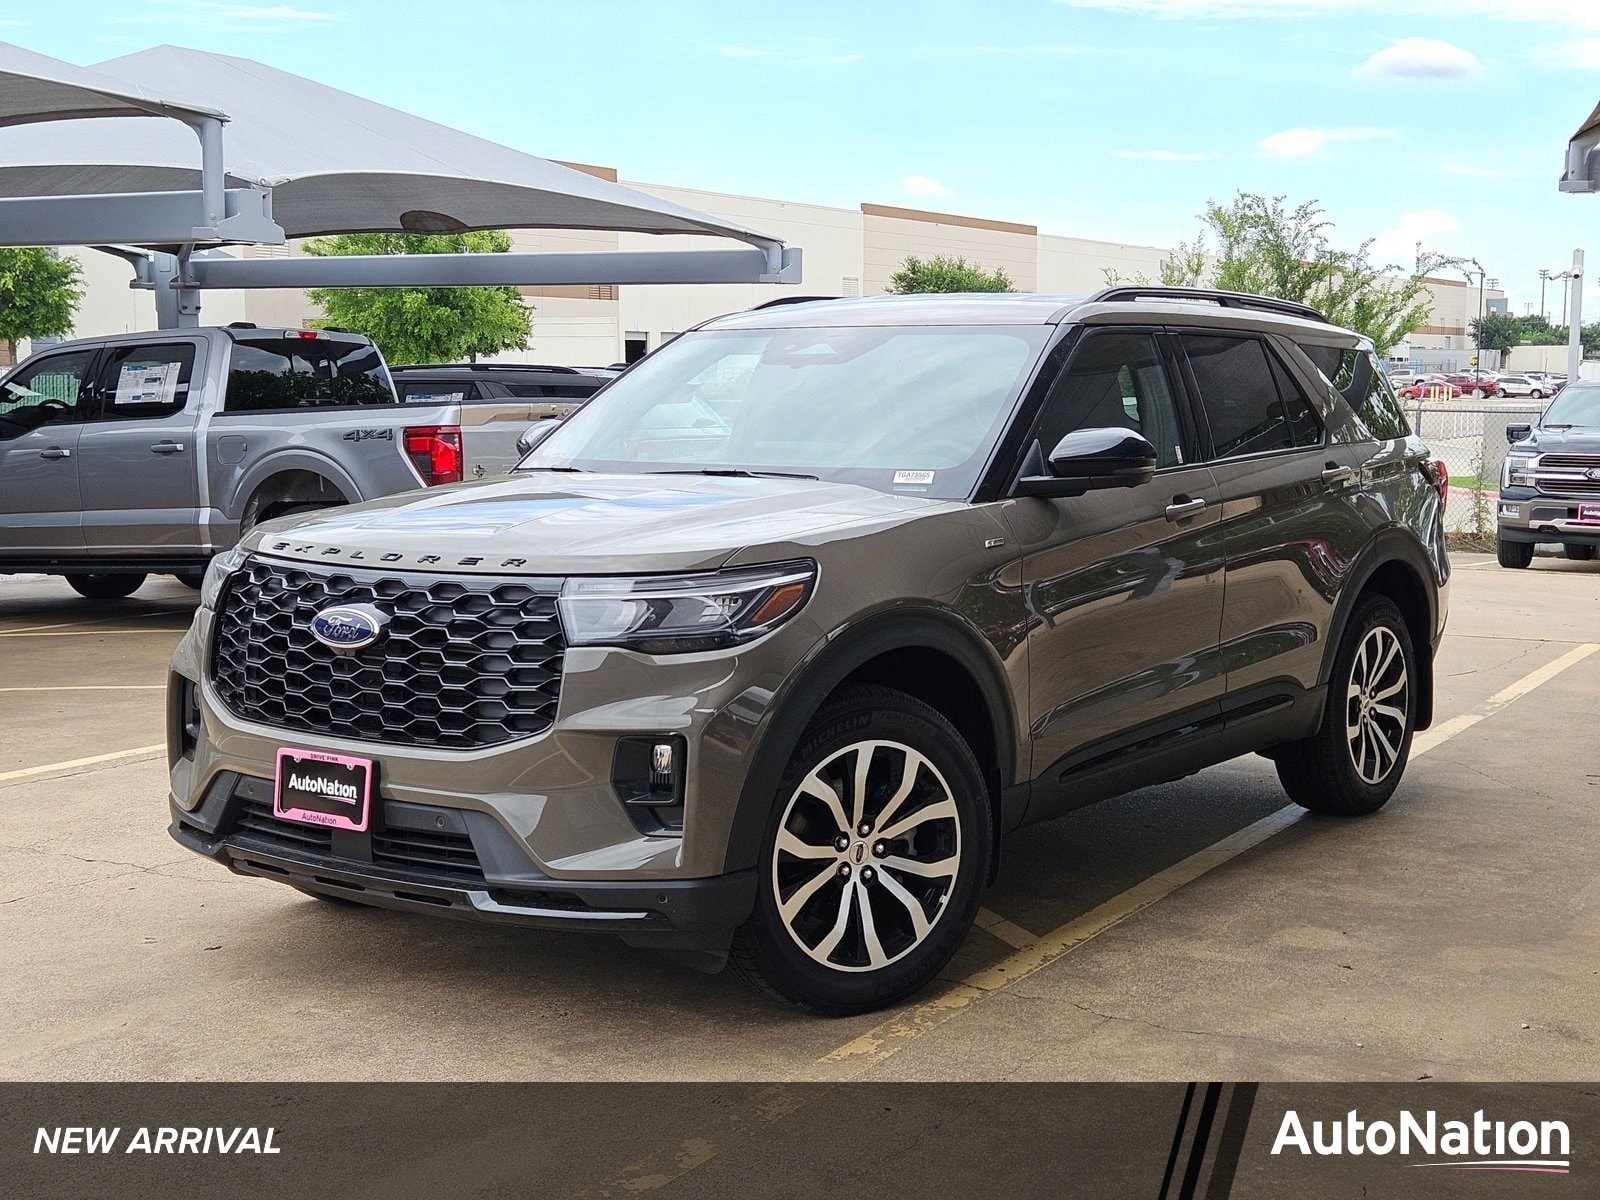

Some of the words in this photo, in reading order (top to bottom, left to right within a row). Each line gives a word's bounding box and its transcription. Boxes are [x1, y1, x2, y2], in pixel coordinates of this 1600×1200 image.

[271, 541, 528, 568] EXPLORER
[321, 614, 361, 639] Ford
[800, 713, 870, 760] MICHELIN
[310, 753, 325, 761] DRIVE
[288, 773, 358, 799] AutoNation
[301, 812, 337, 825] AutoNation
